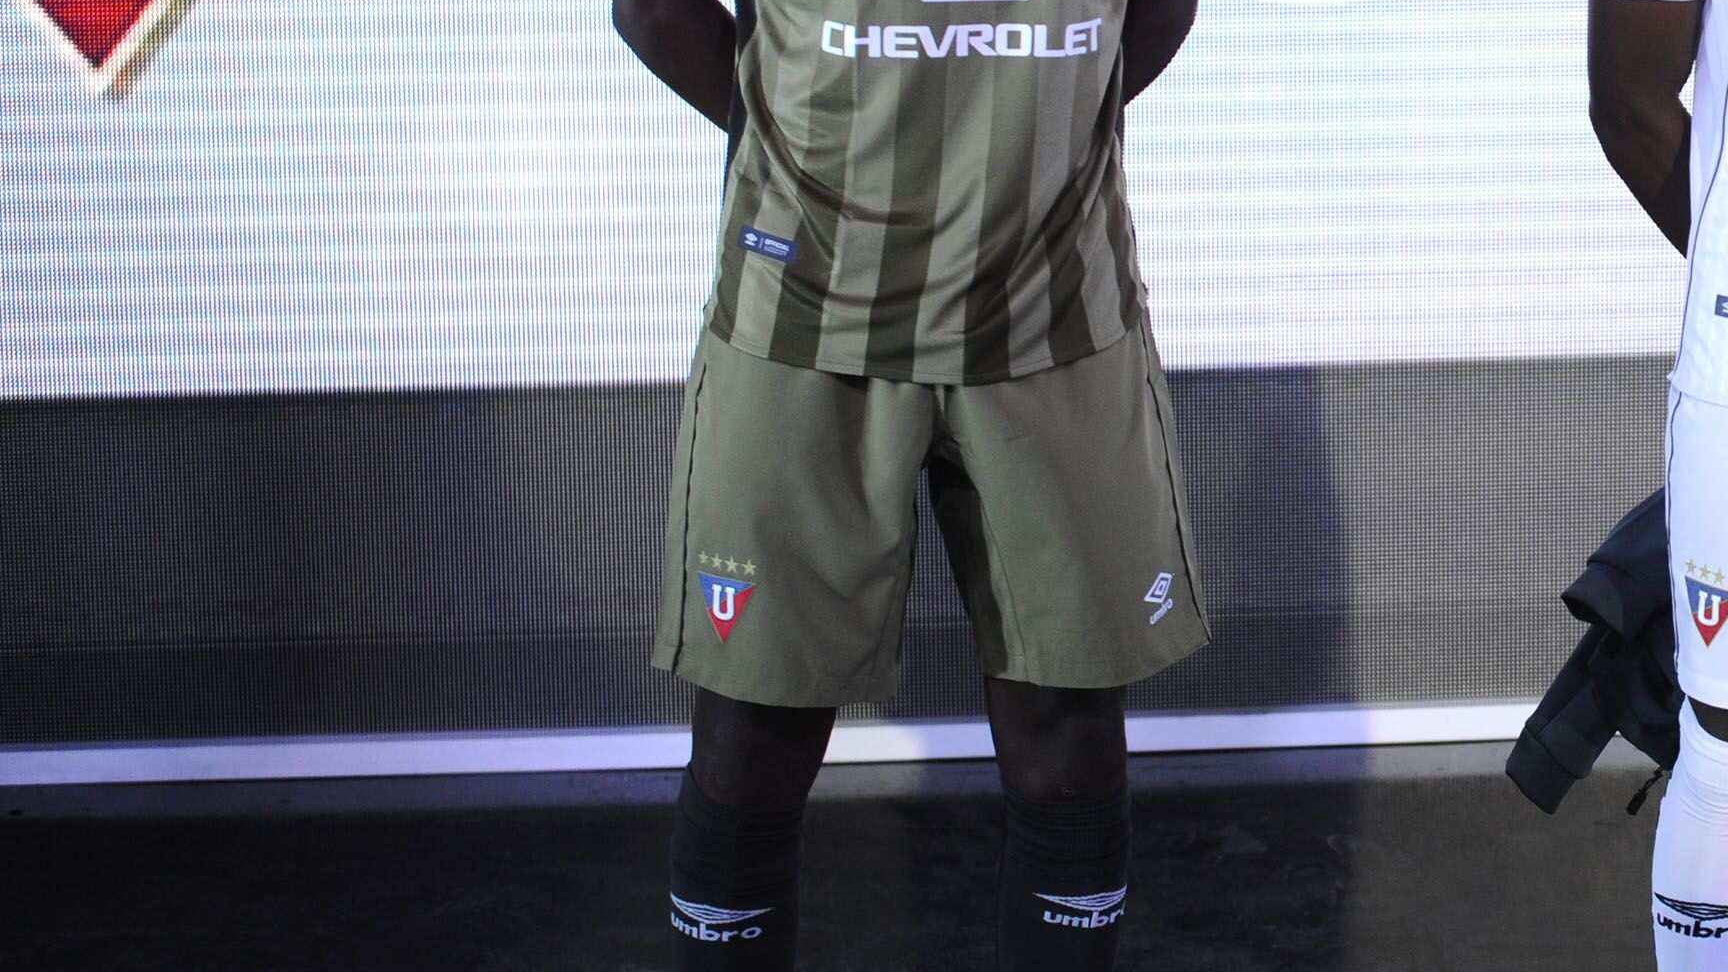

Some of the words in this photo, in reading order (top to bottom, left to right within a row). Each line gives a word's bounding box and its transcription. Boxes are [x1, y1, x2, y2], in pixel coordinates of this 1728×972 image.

[821, 17, 1103, 58] CHEVROLET
[711, 583, 736, 621] U
[1698, 590, 1722, 627] U
[671, 911, 762, 942] umbro
